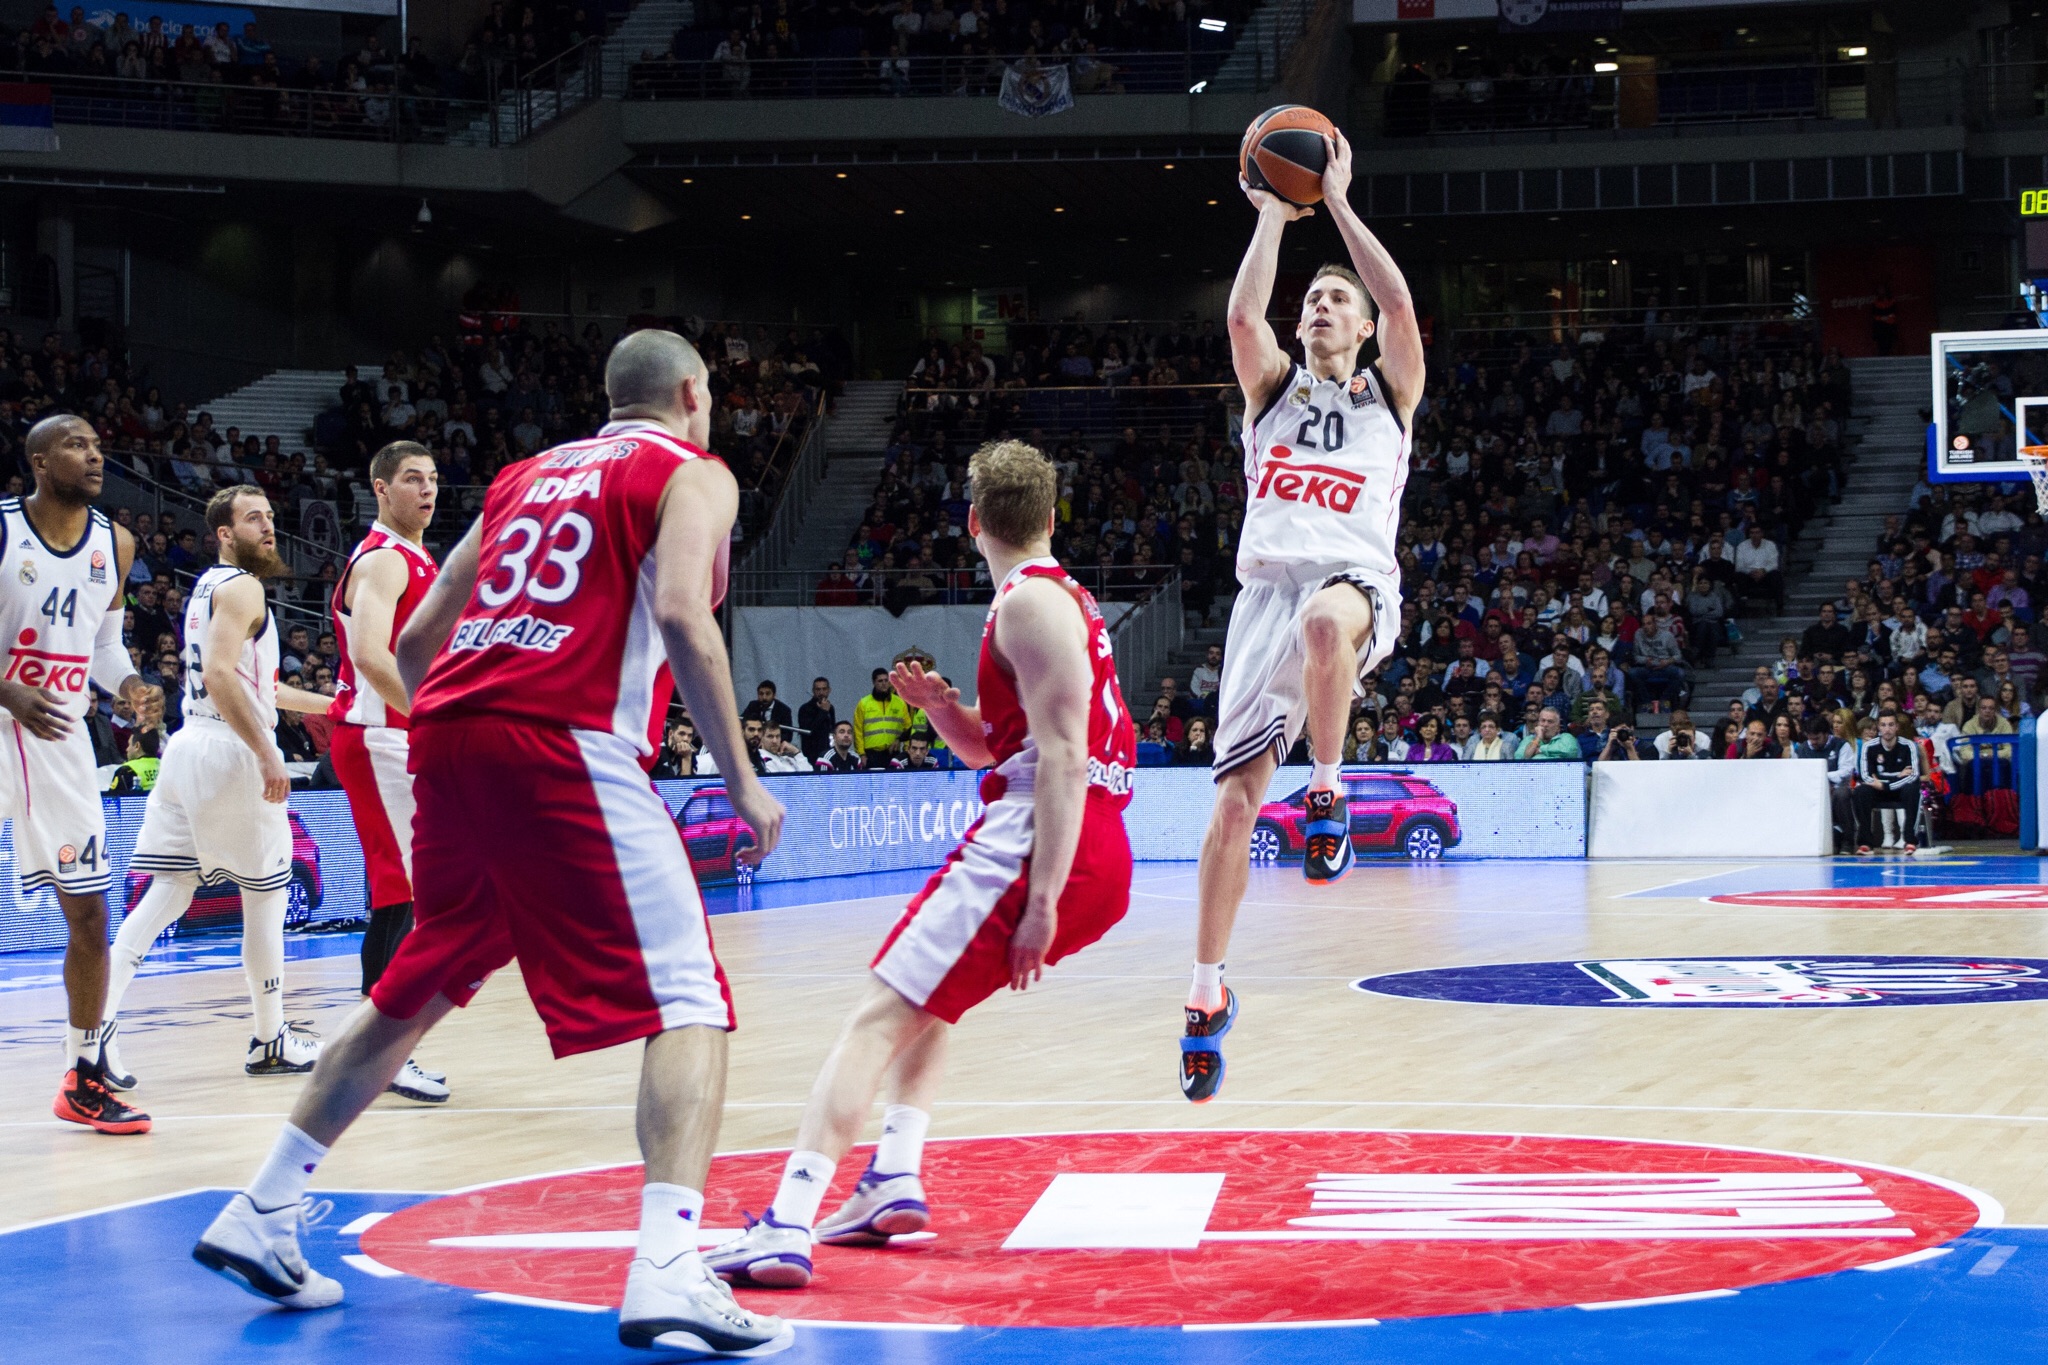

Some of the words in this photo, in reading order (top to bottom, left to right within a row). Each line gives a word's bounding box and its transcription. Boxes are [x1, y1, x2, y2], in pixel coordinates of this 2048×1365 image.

[1296, 405, 1344, 452] 20
[478, 509, 596, 609] 33
[41, 587, 78, 628] 44
[829, 798, 914, 848] CITROËN
[919, 800, 946, 842] C4
